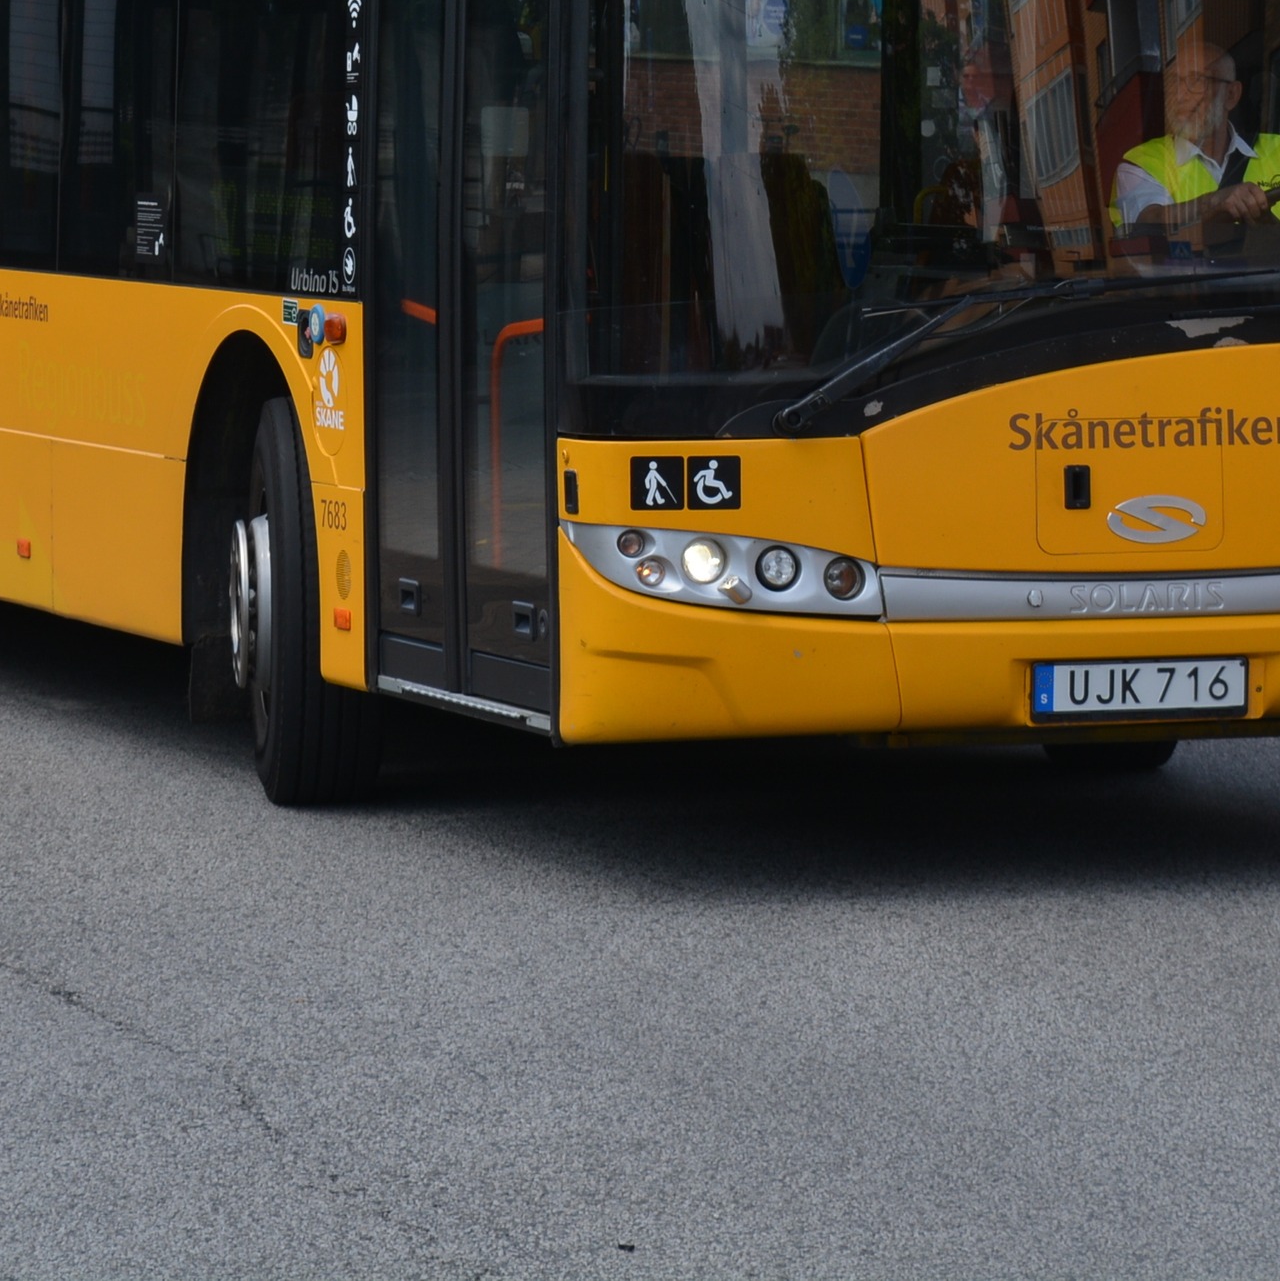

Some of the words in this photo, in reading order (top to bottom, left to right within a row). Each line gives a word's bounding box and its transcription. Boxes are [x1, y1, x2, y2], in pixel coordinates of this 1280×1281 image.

[290, 267, 327, 293] Urbino
[328, 270, 339, 294] 15
[19, 340, 147, 430] Regionbuss
[320, 499, 347, 531] 7683
[1069, 581, 1225, 614] SOLARIS
[1040, 693, 1048, 705] S
[1069, 668, 1141, 706] UJK
[1156, 665, 1229, 704] 716
